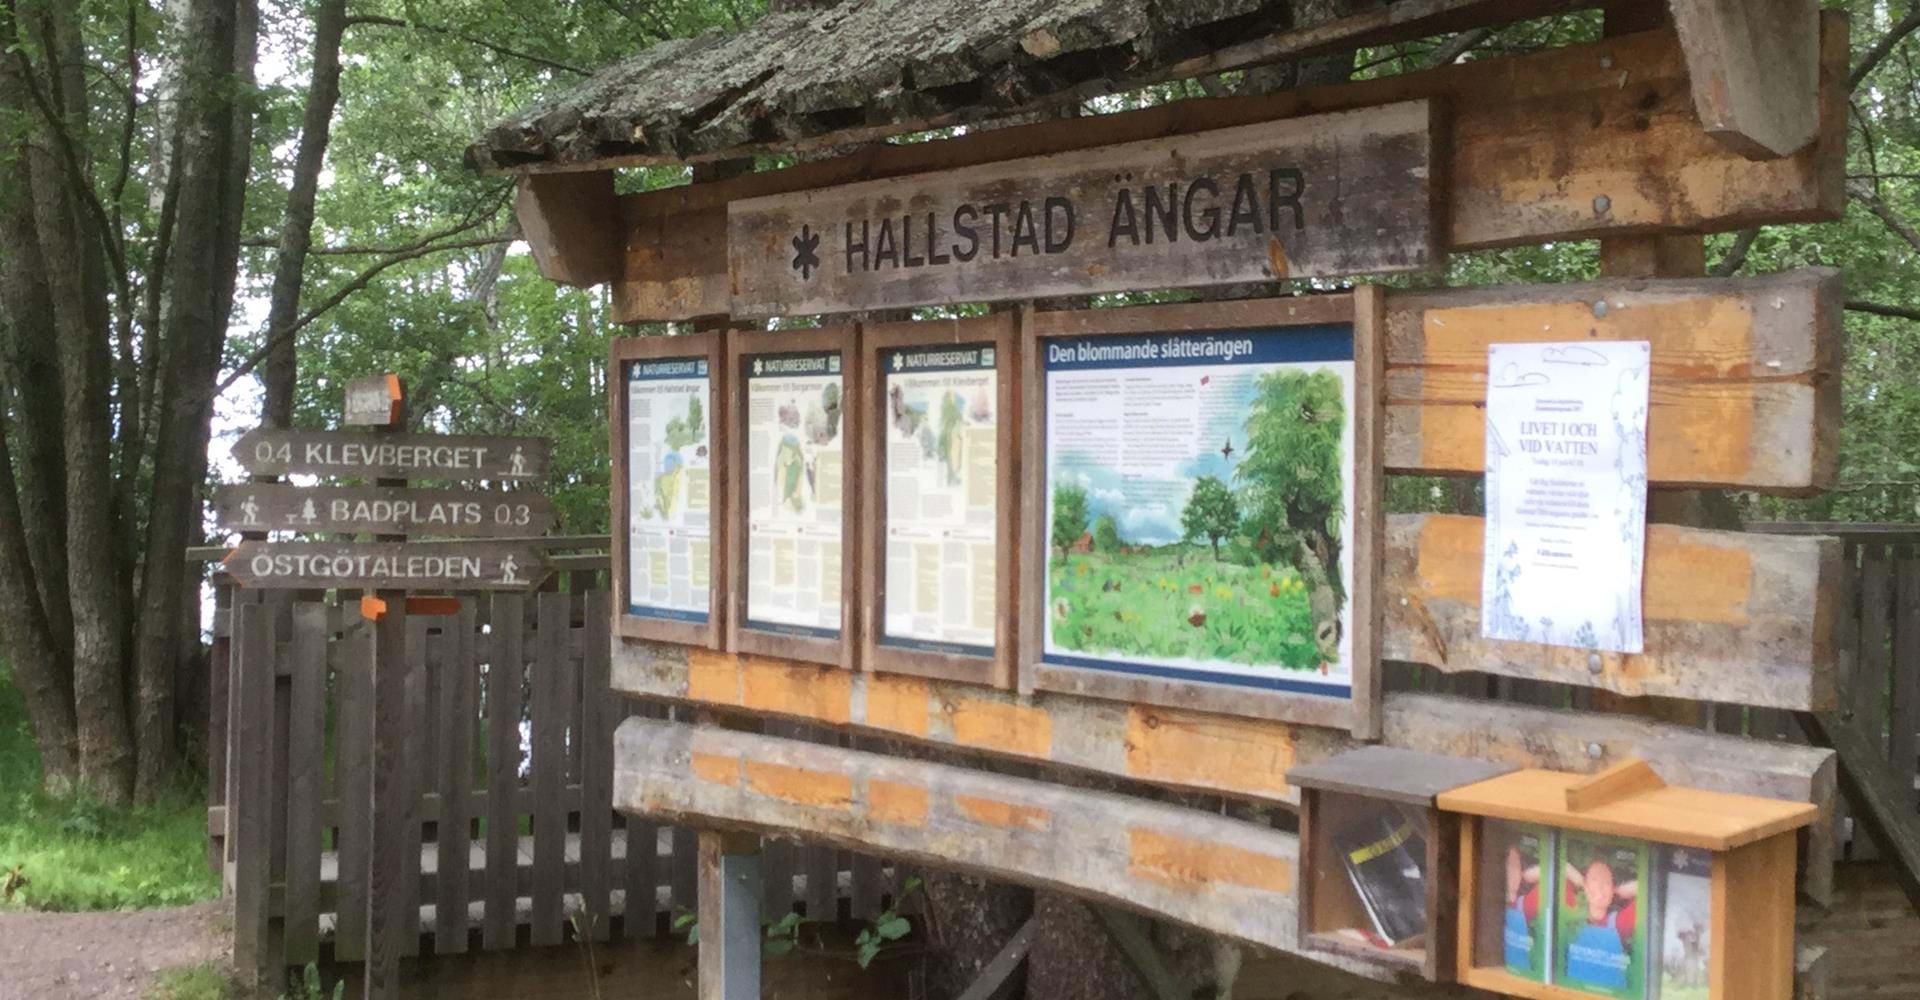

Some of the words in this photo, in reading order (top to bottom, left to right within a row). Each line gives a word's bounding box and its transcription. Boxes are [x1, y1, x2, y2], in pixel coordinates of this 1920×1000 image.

[844, 196, 1075, 274] HALLSTAD
[1108, 167, 1306, 247] ÄNGAR
[906, 351, 978, 367] NATURRESERVAT
[1050, 344, 1076, 363] Den
[1078, 340, 1158, 361] blommande
[1161, 338, 1252, 361] slåtterängen
[642, 361, 696, 375] NATURRESERVAT
[765, 357, 826, 372] NATURRESERVAT
[1520, 421, 1557, 436] LIVET
[1561, 422, 1566, 436] I
[1568, 422, 1598, 437] OCH
[255, 441, 292, 464] 0.4
[305, 444, 488, 469] KLEVBERGET
[1519, 438, 1542, 453] VID
[1544, 440, 1599, 456] VATTEN
[331, 500, 482, 525] BADPLATS
[494, 504, 531, 526] 0.3
[251, 548, 481, 578] ÖSTGÖTALEDEN
